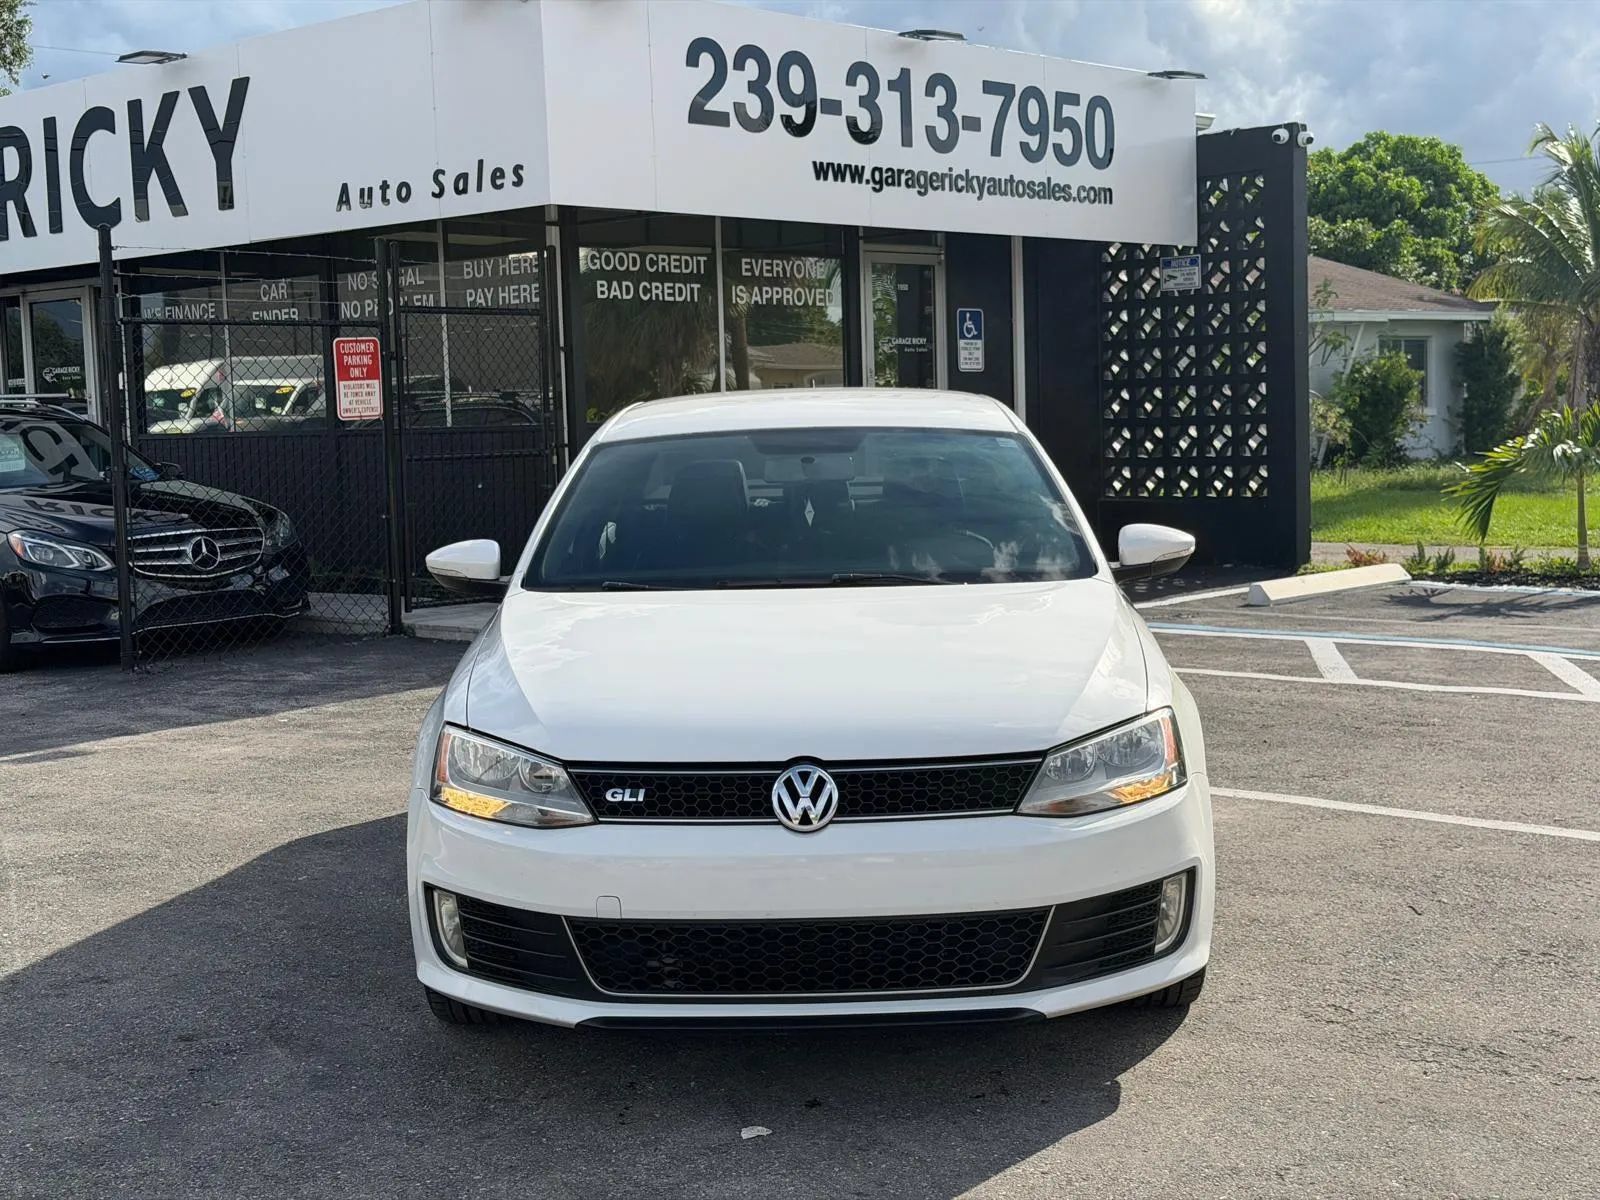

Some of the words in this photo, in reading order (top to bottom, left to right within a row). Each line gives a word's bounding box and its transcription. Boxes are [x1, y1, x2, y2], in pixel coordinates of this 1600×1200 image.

[686, 37, 1115, 170] 239-313-7950
[0, 77, 250, 241] RICKY
[336, 180, 412, 212] Auto
[431, 159, 524, 199] Sales
[812, 160, 1113, 205] www.garagerickyautosales.com
[463, 259, 494, 279] BUY
[499, 255, 539, 276] HERE
[587, 251, 641, 272] GOOD
[646, 253, 707, 274] CREDIT
[741, 258, 826, 279] EVERYONE
[347, 272, 368, 291] NO
[371, 266, 424, 290] SIAL
[260, 283, 288, 301] CAR
[466, 287, 494, 307] PAY
[498, 283, 540, 305] HERE
[596, 280, 634, 300] BAD
[639, 281, 701, 302] CREDIT
[732, 285, 746, 304] IS
[751, 286, 834, 307] APPROVED
[165, 302, 216, 319] FINANCE
[341, 300, 361, 319] NO
[340, 342, 375, 353] CUSTOMER
[343, 354, 373, 366] PARKING
[350, 367, 368, 378] ONLY
[605, 788, 646, 802] GLI
